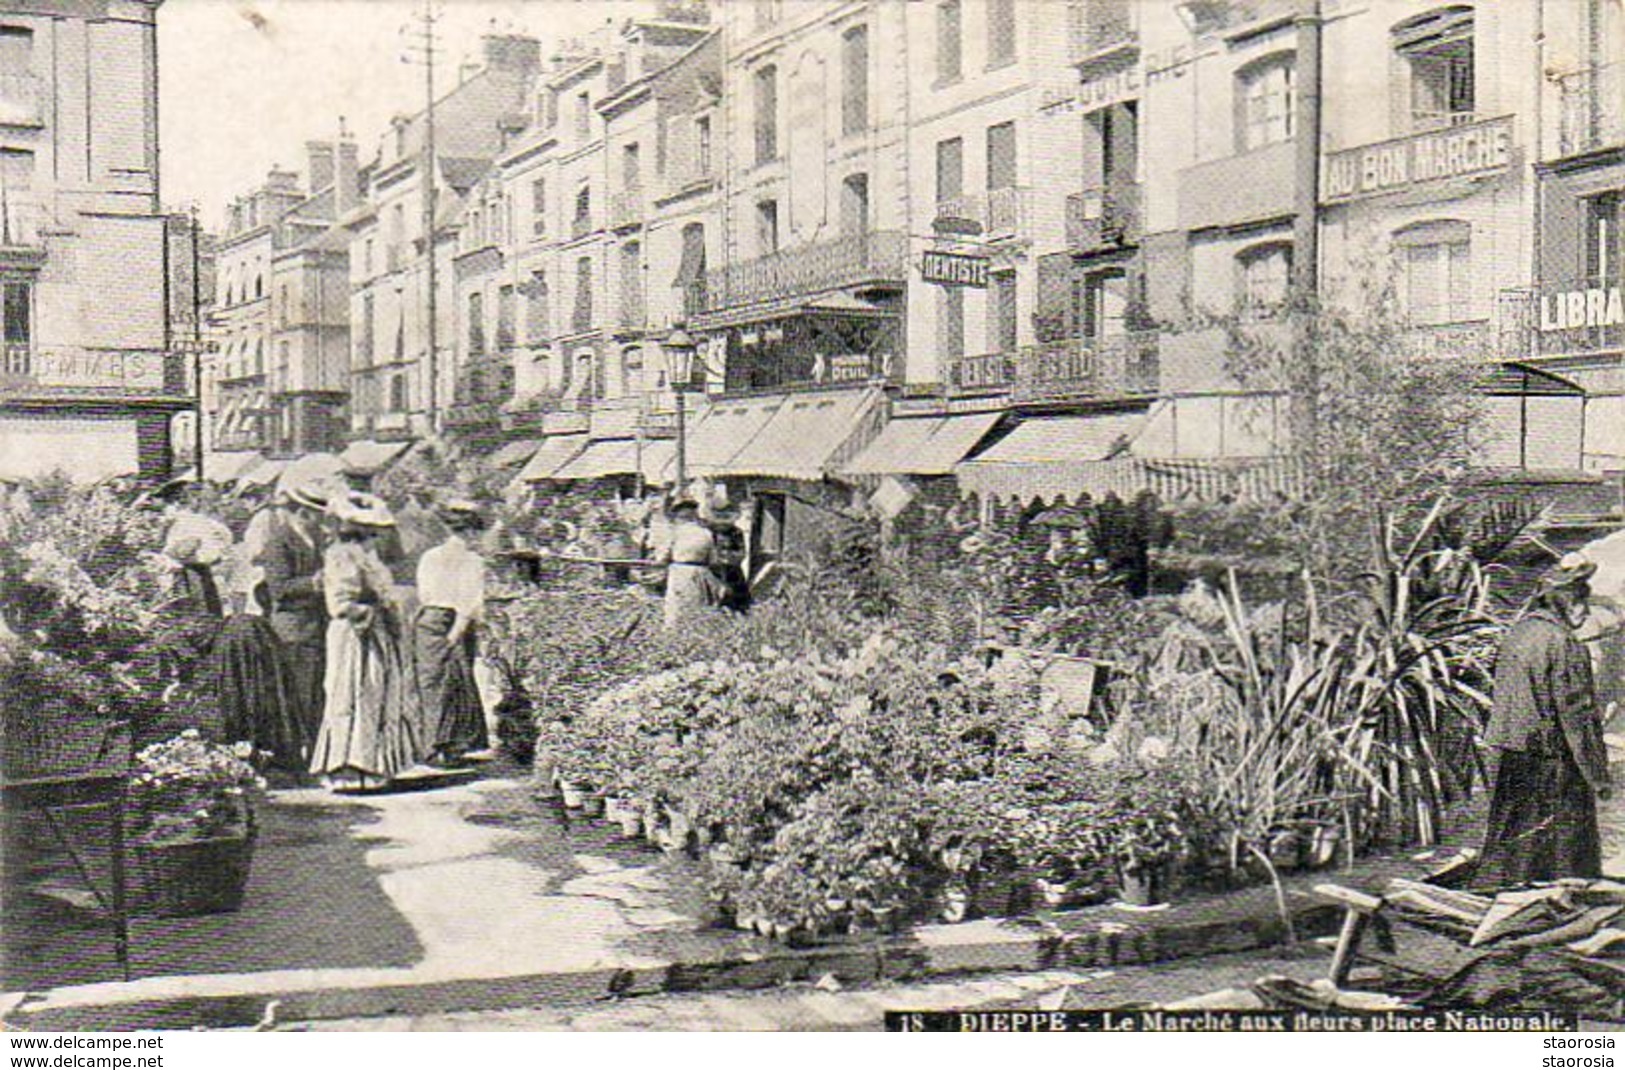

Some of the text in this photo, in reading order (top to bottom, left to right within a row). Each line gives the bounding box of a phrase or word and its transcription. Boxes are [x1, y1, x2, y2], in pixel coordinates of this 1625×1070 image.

[1325, 157, 1352, 197] AU
[1361, 147, 1406, 191] BON
[926, 254, 989, 284] DENTISTE
